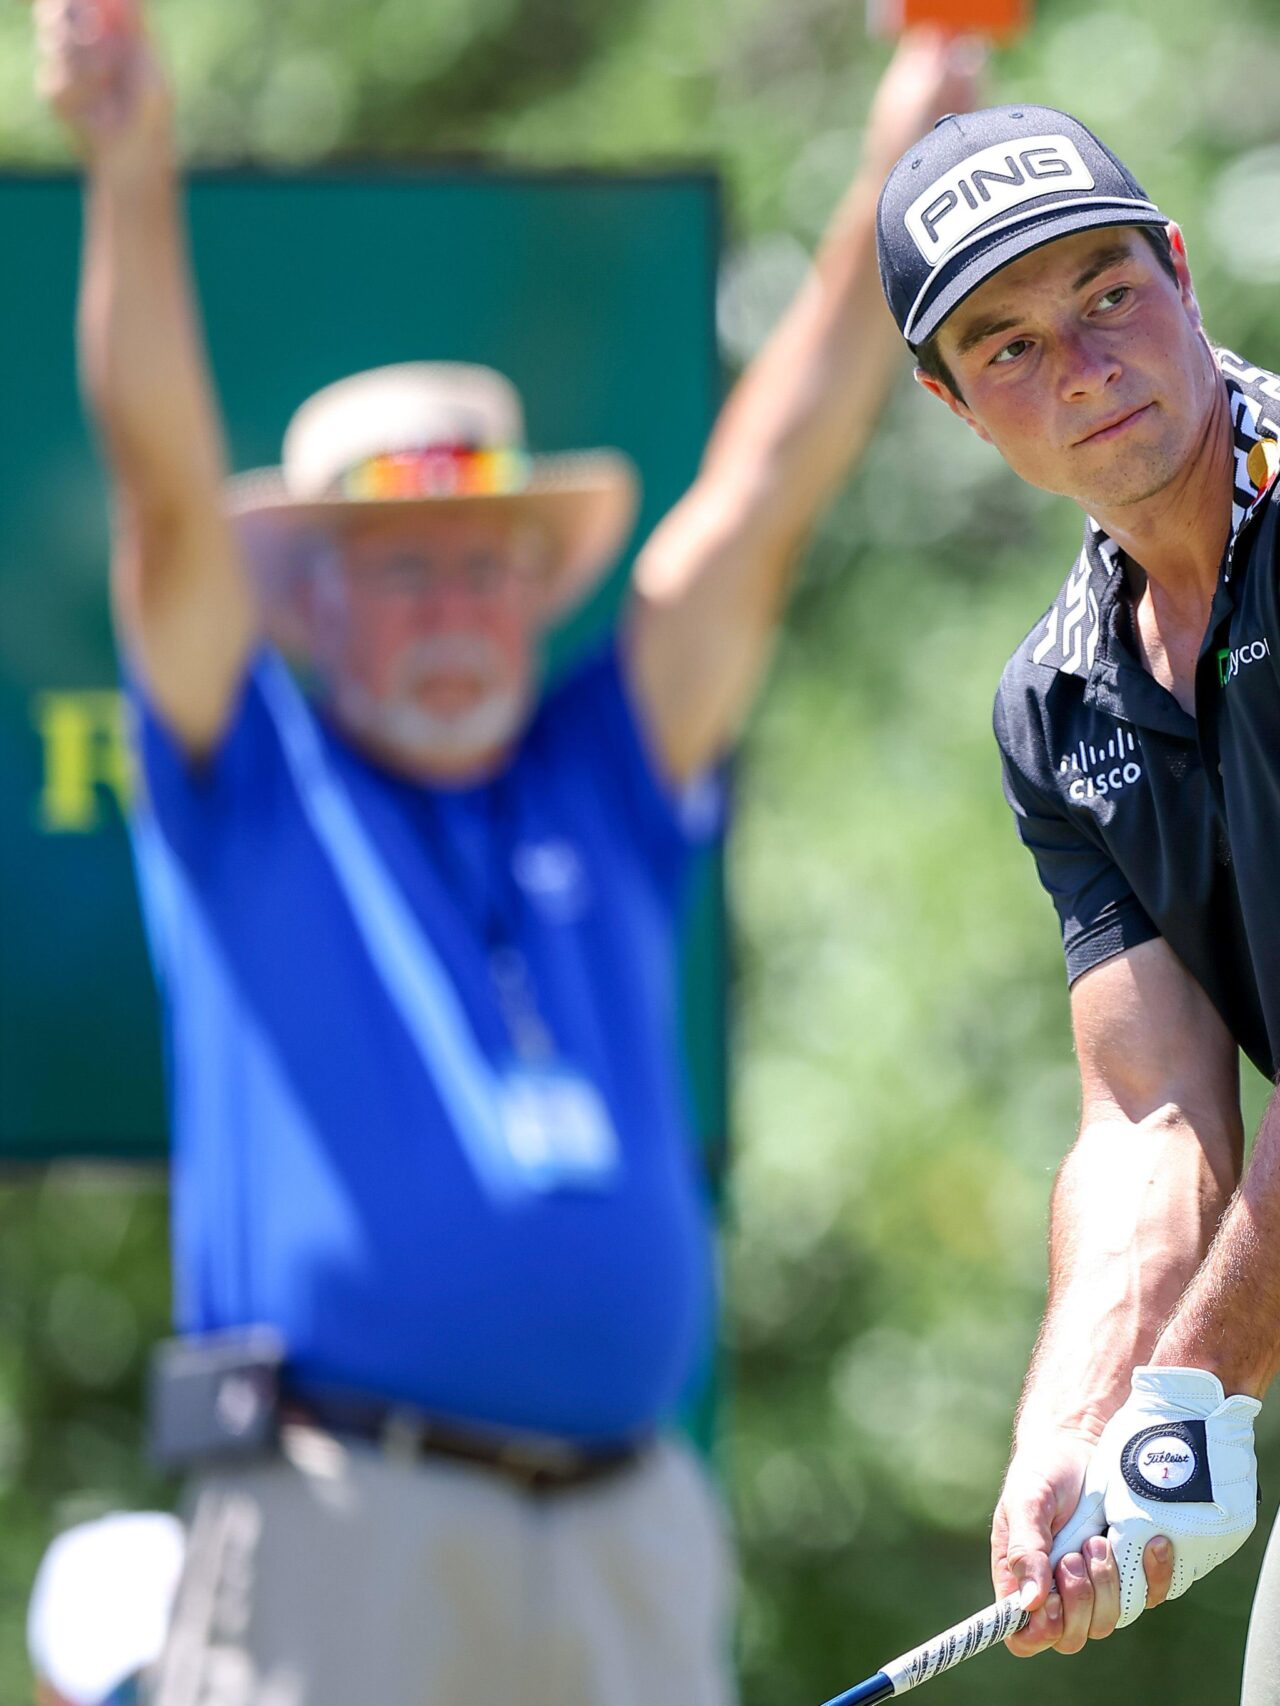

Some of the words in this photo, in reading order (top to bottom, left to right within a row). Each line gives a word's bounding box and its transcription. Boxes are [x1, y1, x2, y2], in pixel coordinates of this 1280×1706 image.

[920, 147, 1072, 244] PING
[1143, 1450, 1190, 1466] Titleist
[1161, 1466, 1169, 1479] 1
